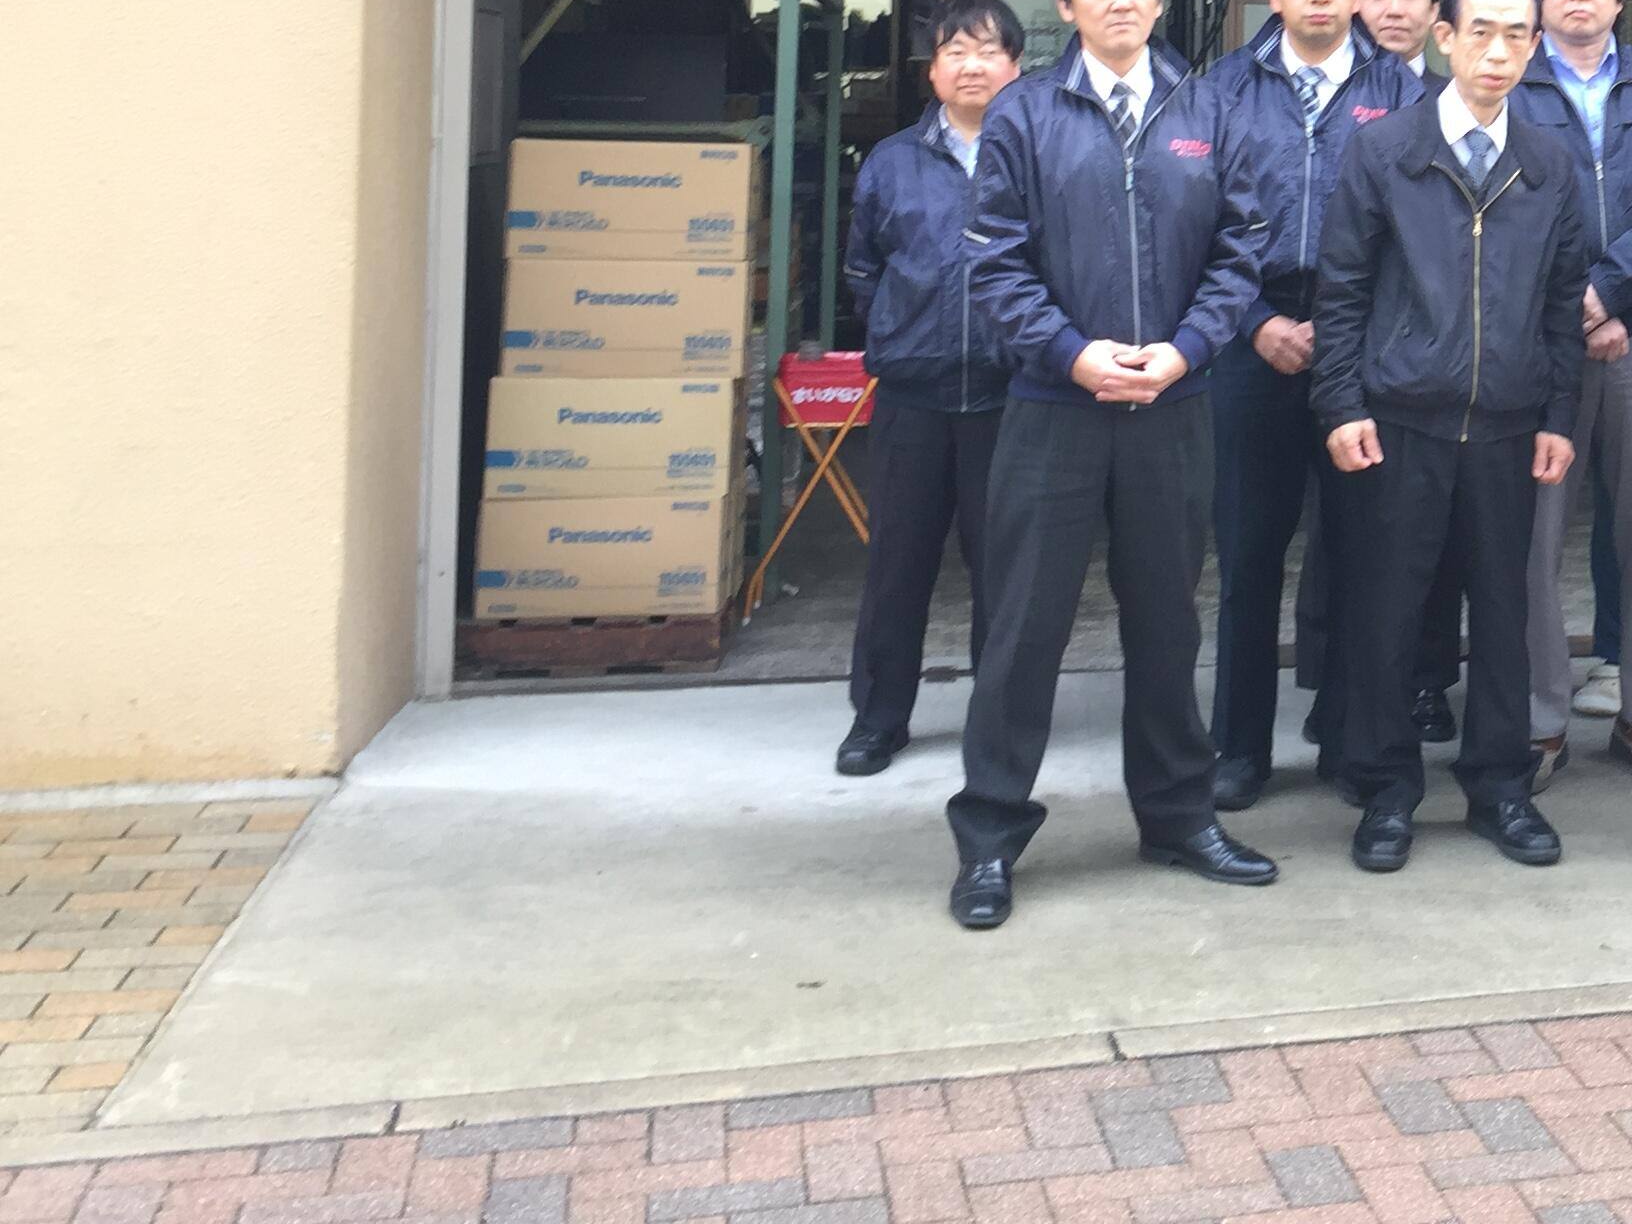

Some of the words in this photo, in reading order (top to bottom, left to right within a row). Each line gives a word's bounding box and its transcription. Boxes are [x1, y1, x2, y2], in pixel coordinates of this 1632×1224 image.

[577, 170, 682, 188] Panasonic
[573, 289, 678, 306] Panasonic
[557, 407, 662, 425] Panasonic
[546, 526, 652, 544] Panasonic
